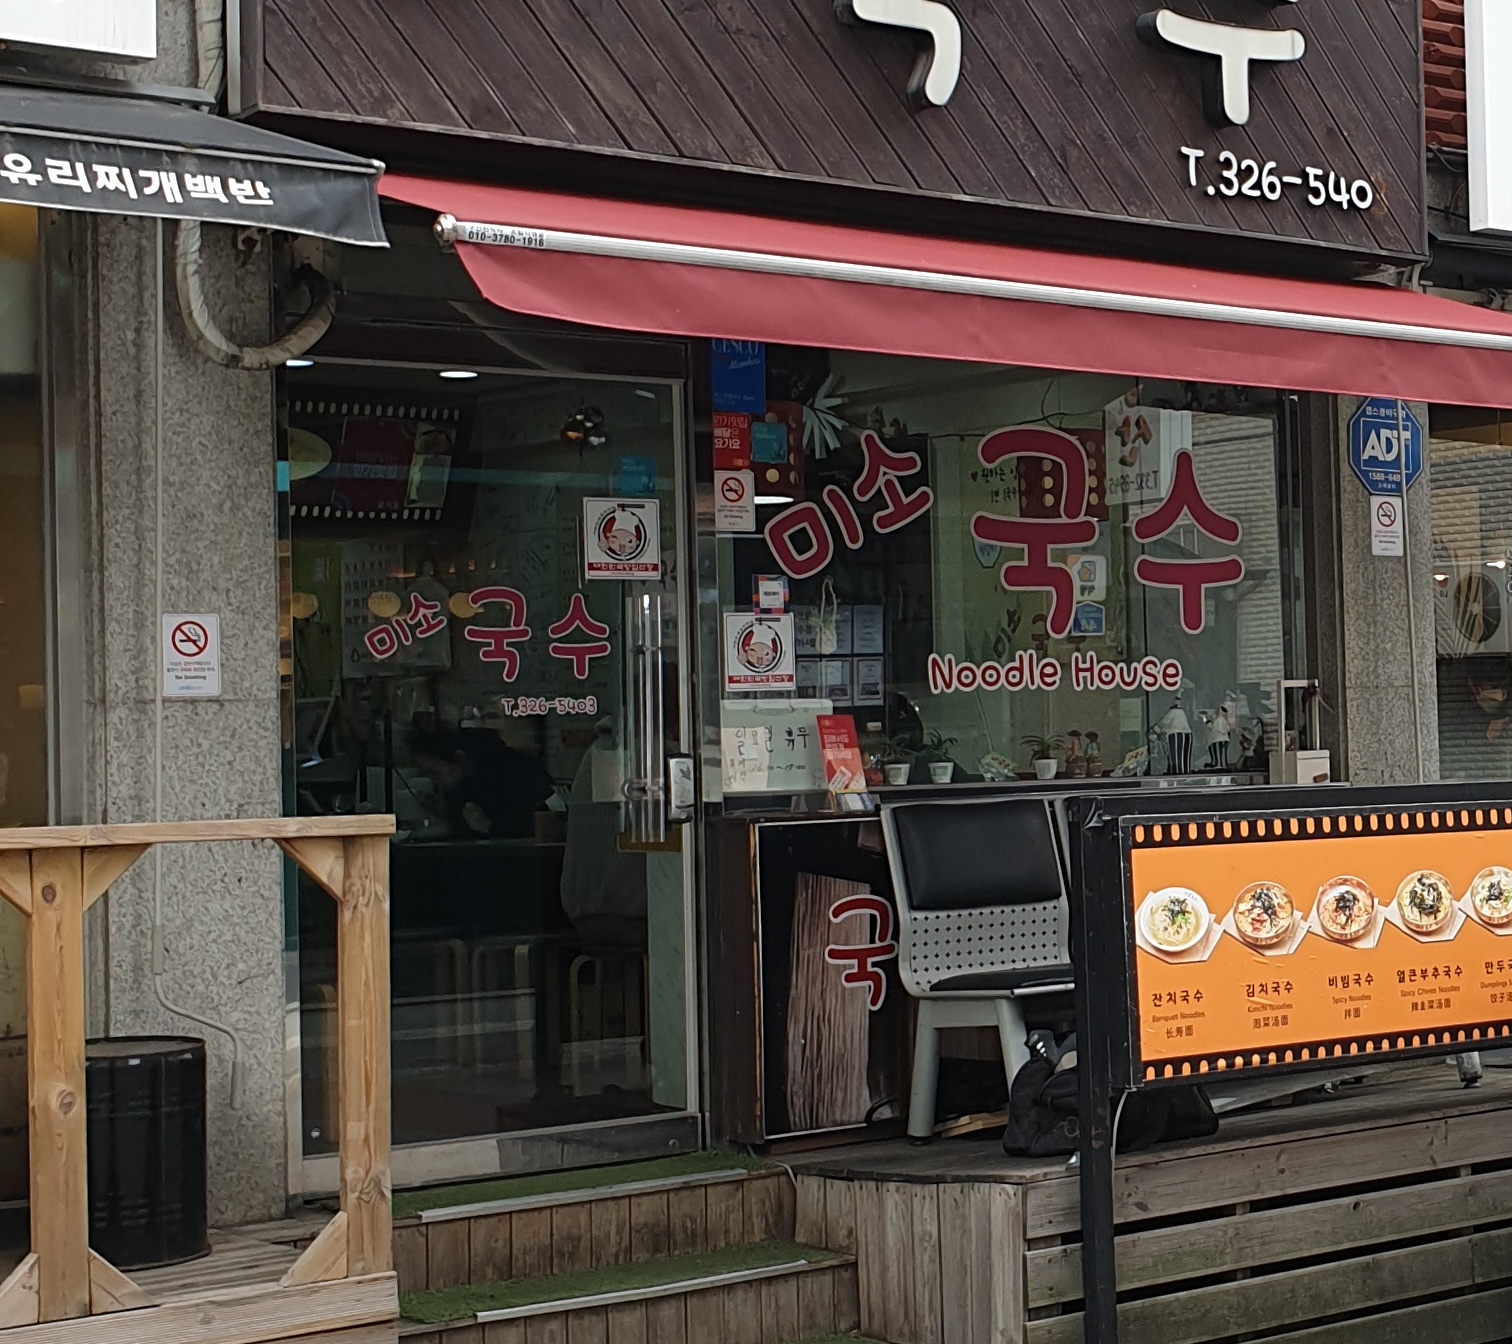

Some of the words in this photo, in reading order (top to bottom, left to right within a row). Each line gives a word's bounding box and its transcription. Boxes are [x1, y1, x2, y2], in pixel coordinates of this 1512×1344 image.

[713, 438, 741, 450] 요기요
[1362, 427, 1412, 462] ADT
[764, 428, 934, 580] 미소
[969, 425, 1246, 640] 국수
[363, 591, 448, 660] 미소
[463, 585, 611, 683] 국수
[927, 650, 1063, 694] Noodle
[1071, 651, 1182, 692] House
[501, 696, 599, 717] T.326-5403
[824, 893, 899, 1011] 국
[1245, 979, 1295, 999] 김치국수
[1328, 972, 1375, 990] 비빔국수
[1151, 987, 1205, 1008] 잔치국수
